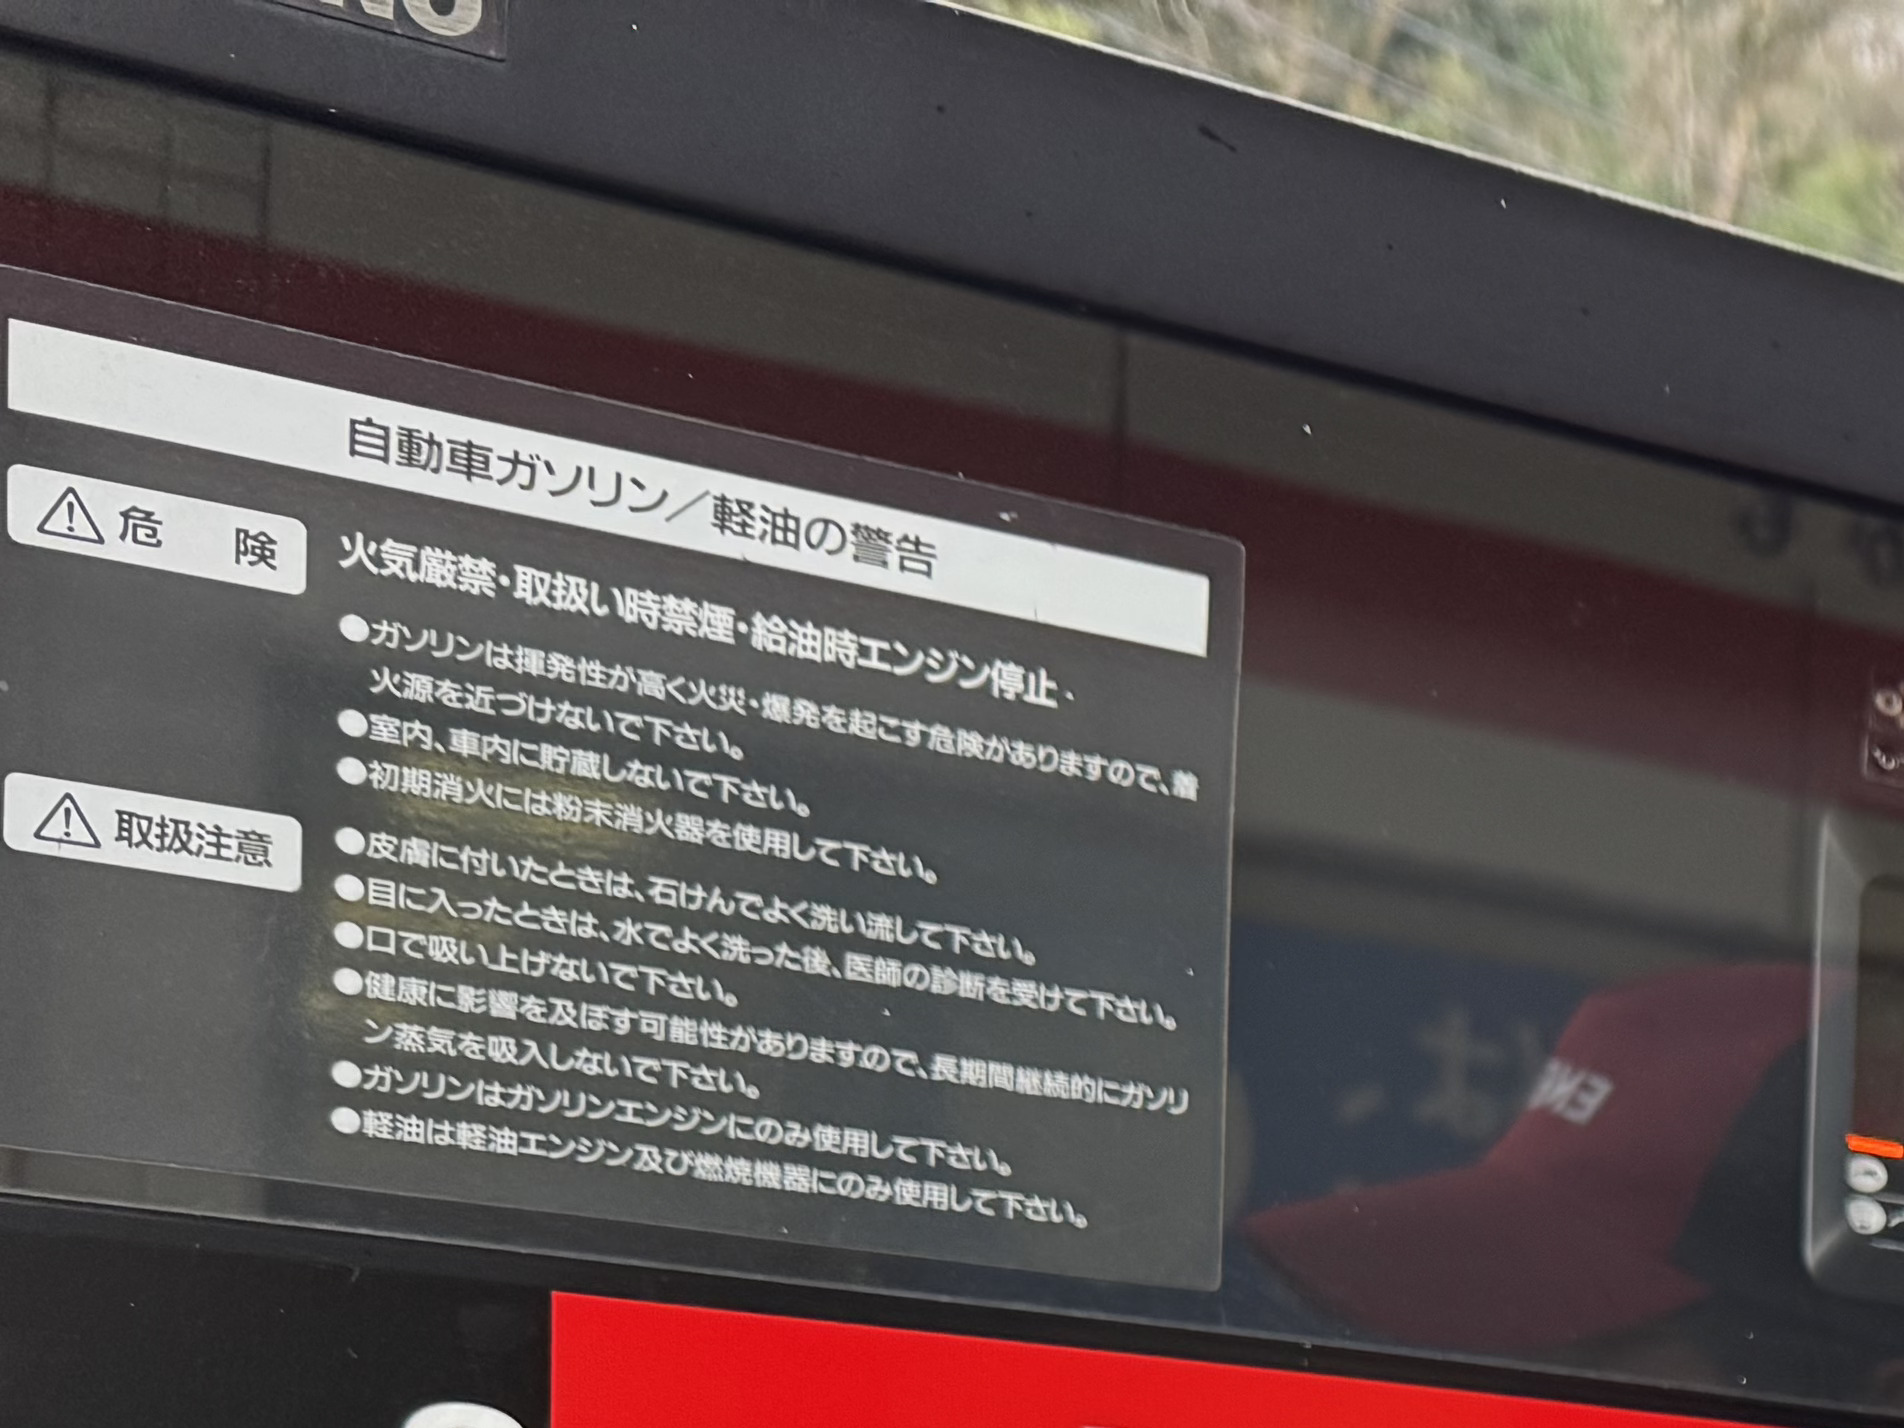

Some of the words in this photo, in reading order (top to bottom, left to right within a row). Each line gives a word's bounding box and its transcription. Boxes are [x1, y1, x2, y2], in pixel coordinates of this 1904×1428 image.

[369, 667, 743, 761] 火源を近づけないで下さい。
[367, 712, 811, 818] 室内、車内に貯蔵しないで下さい。
[114, 808, 274, 869] 取扱注意
[367, 758, 938, 885] 初期消火には粉末消火器を使用して下さい。
[366, 831, 1037, 967] 皮膚に付いたときは、石けんでよく洗い流して下さい。
[366, 926, 739, 1007] 口で吸い上げないで下さい。
[362, 1018, 760, 1101] ン蒸気を吸入しないで下さい。
[361, 1064, 1012, 1177] ガソリンはガソリンエンジンにのみ使用して下さい。
